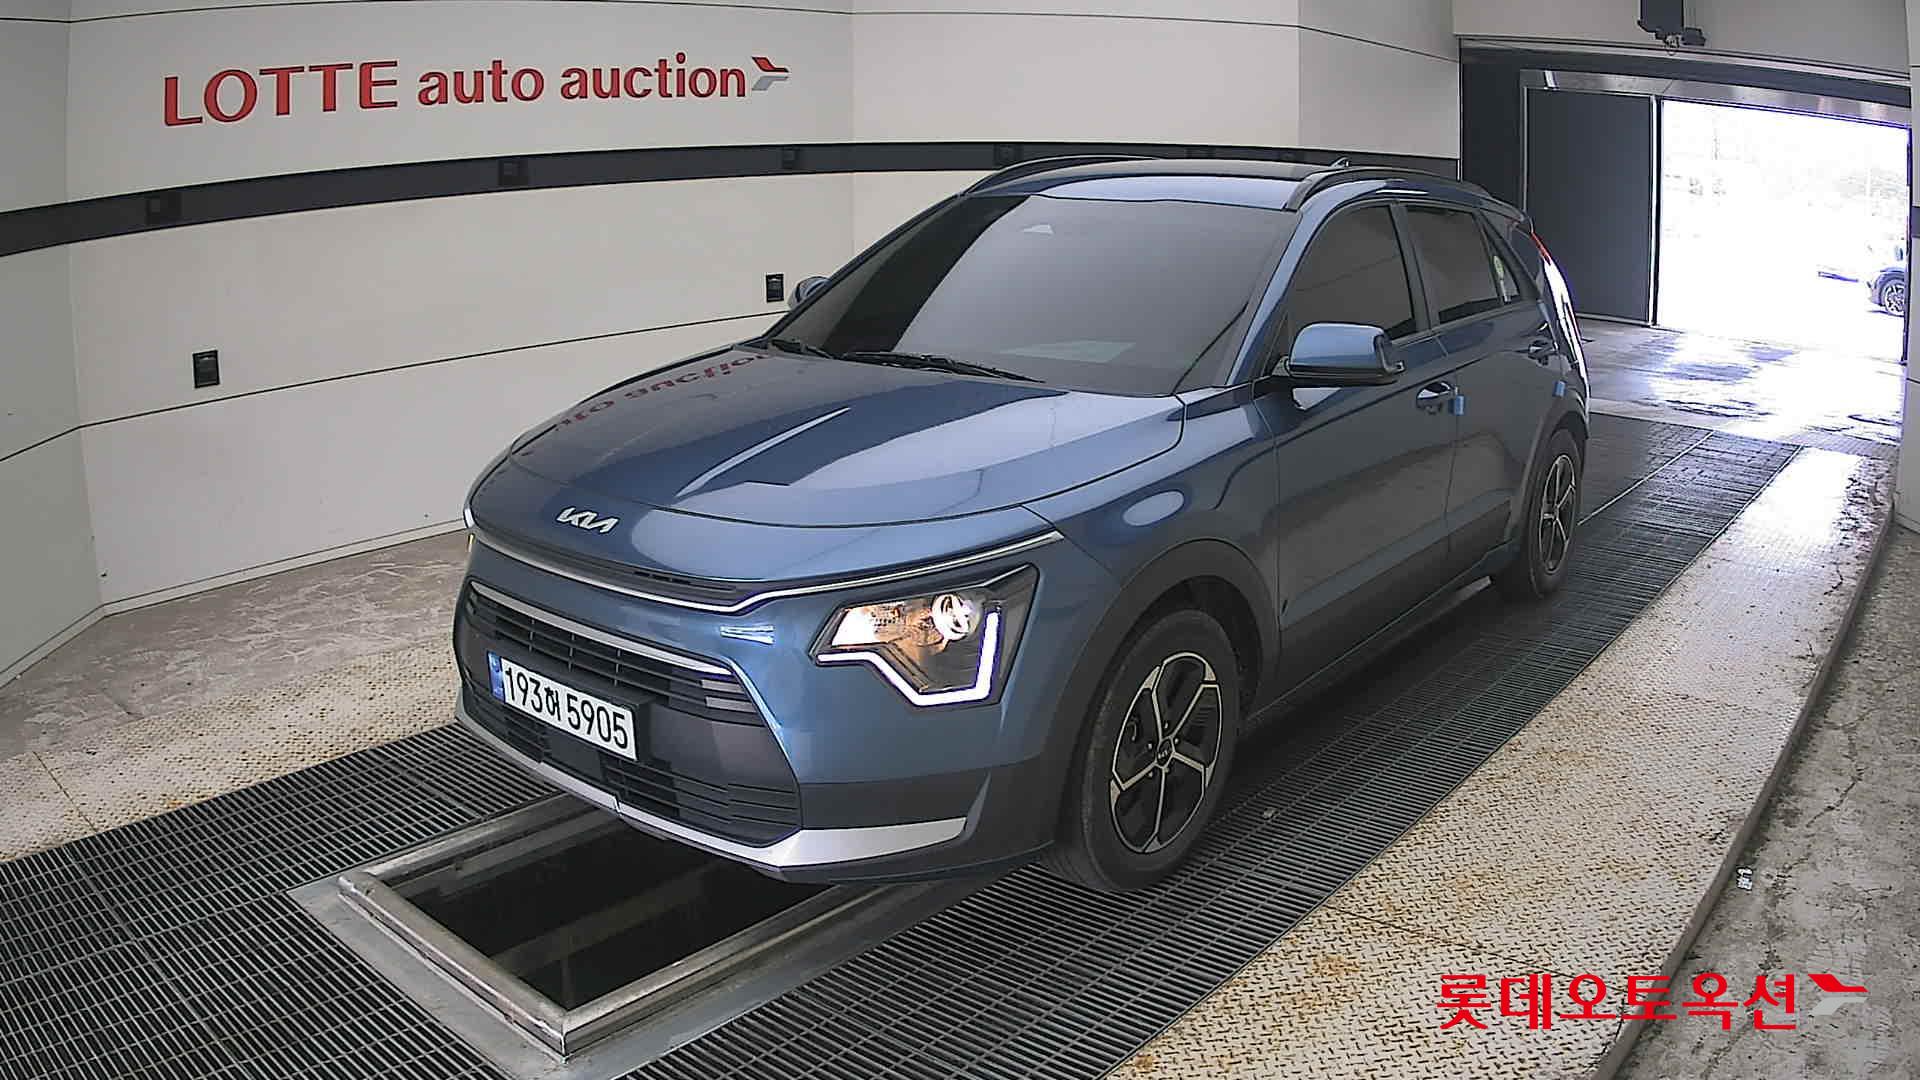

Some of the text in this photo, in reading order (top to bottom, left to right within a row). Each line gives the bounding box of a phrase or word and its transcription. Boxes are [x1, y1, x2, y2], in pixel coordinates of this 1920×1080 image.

[163, 51, 748, 127] LOTTE auto auction
[556, 507, 620, 534] KIA
[505, 667, 629, 750] 193허 5905
